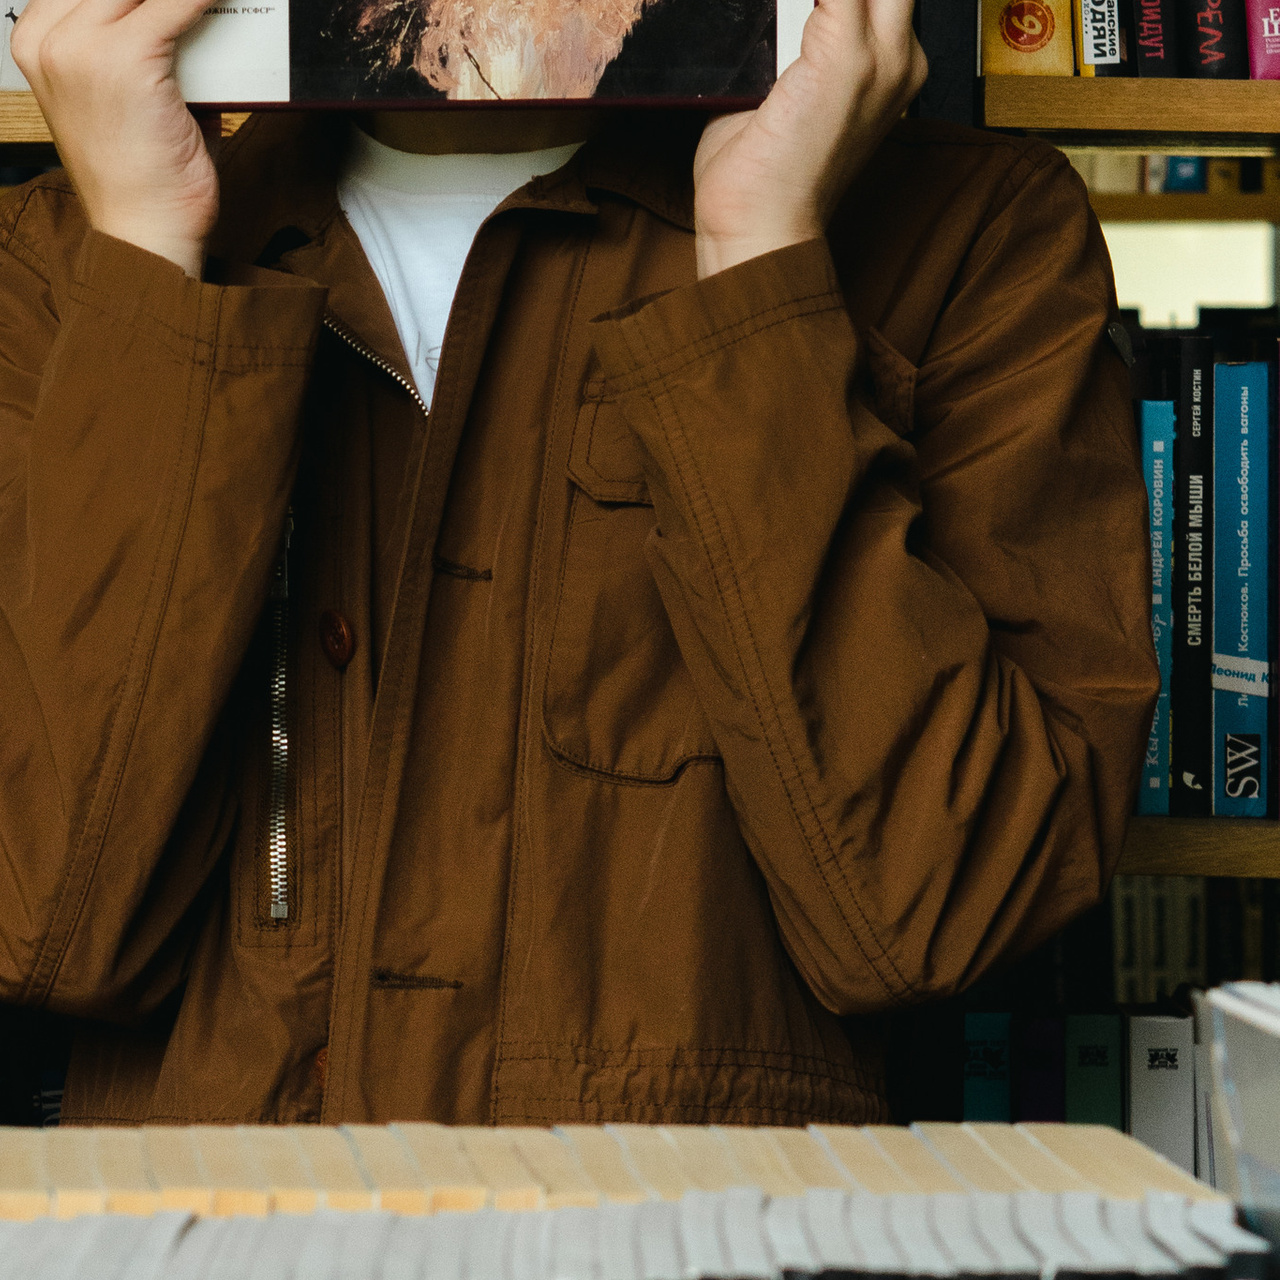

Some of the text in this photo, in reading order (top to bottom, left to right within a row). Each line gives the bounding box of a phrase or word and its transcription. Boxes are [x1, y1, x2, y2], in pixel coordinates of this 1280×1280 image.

[1191, 368, 1202, 438] СЕРГЕЙ КОСТИН
[1240, 386, 1249, 434] вагоны
[1237, 439, 1250, 515] освободить
[1186, 474, 1204, 647] СМЕРТЬ БЕЛОЙ МЫШИ
[1237, 520, 1250, 577] Просьба
[1225, 732, 1261, 799] SW
